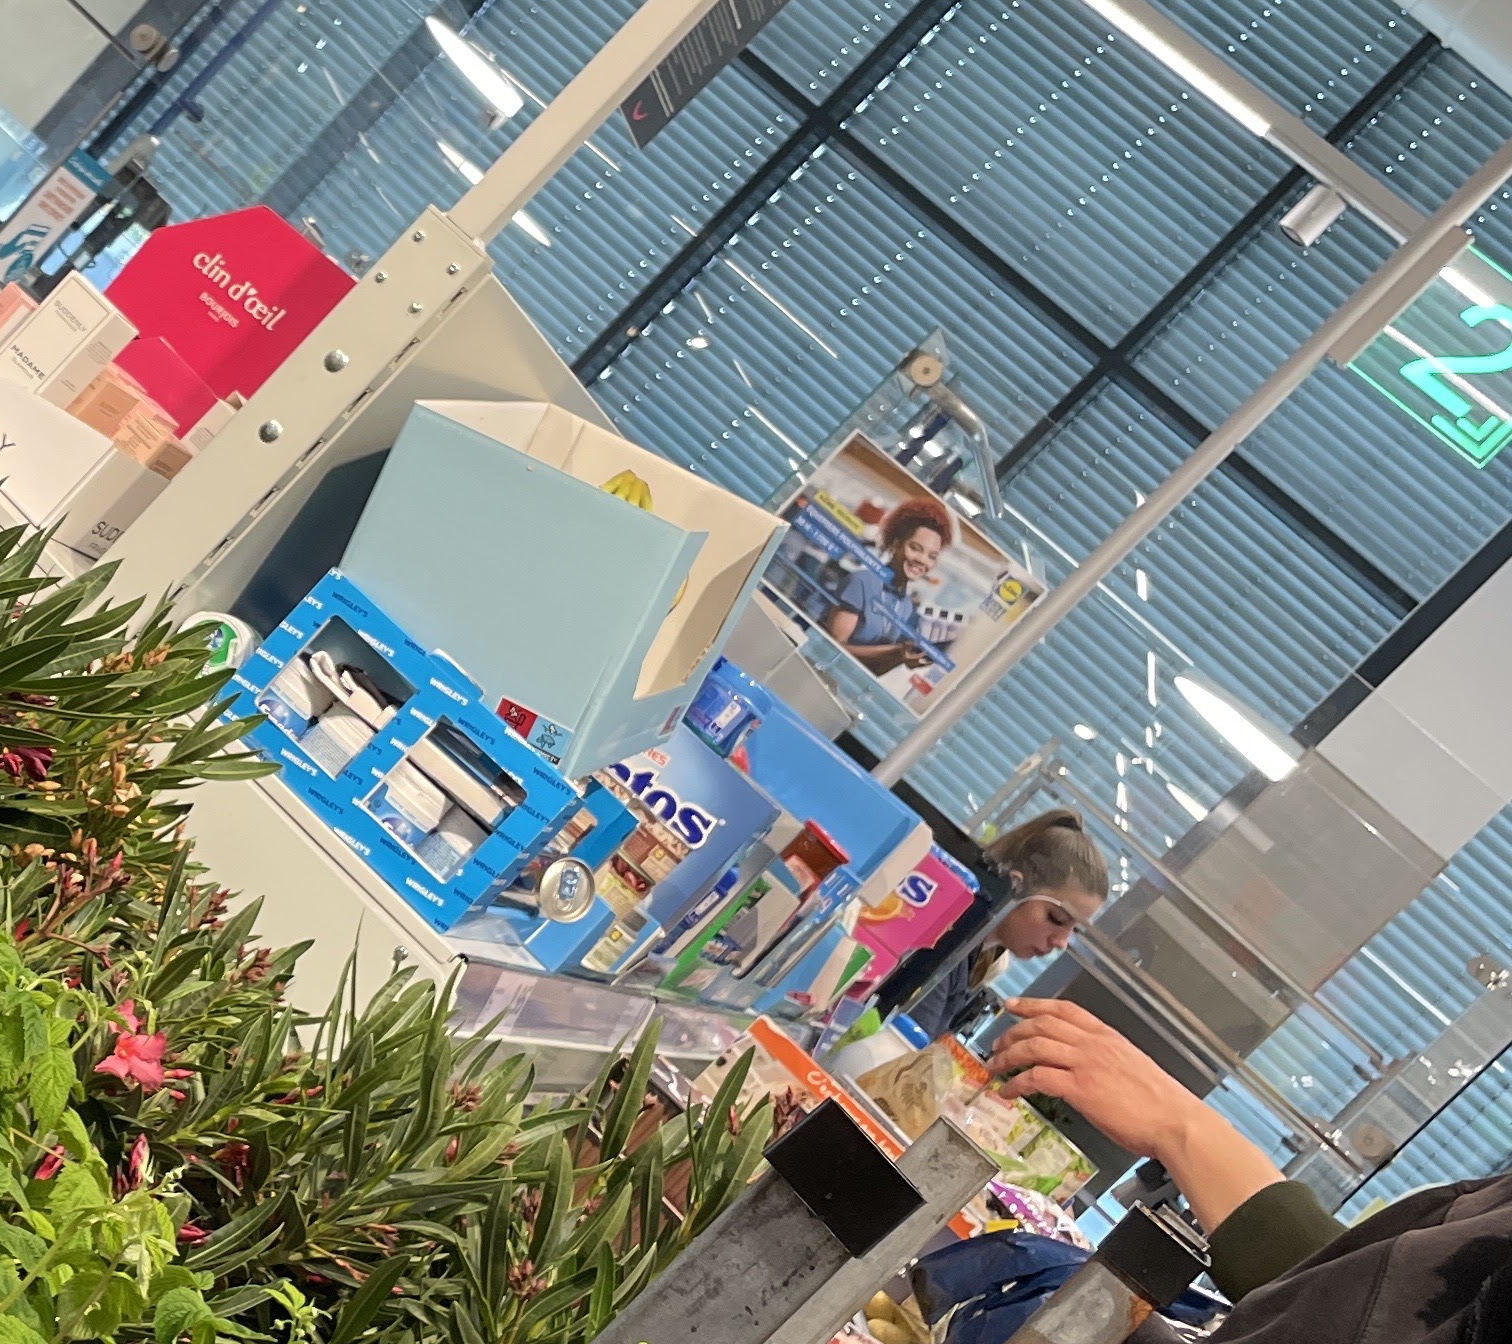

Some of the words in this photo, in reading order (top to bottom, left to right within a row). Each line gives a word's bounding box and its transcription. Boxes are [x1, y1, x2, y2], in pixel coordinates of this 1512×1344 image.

[192, 252, 232, 289] clin
[53, 299, 88, 333] SUDDENLY
[199, 292, 240, 328] BOURJOIS
[9, 345, 45, 380] MADAME
[1399, 303, 1512, 418] 2
[332, 591, 369, 618] WRIGLEY'S
[429, 677, 469, 707] WRIGLEY'S
[458, 716, 496, 746] WRIGLEY'S
[280, 748, 319, 777] WRIGLEY'S
[532, 766, 571, 796] WRIGLEY'S
[308, 787, 344, 815] WRIGLEY'S
[405, 877, 445, 907] WRIGLEY'S
